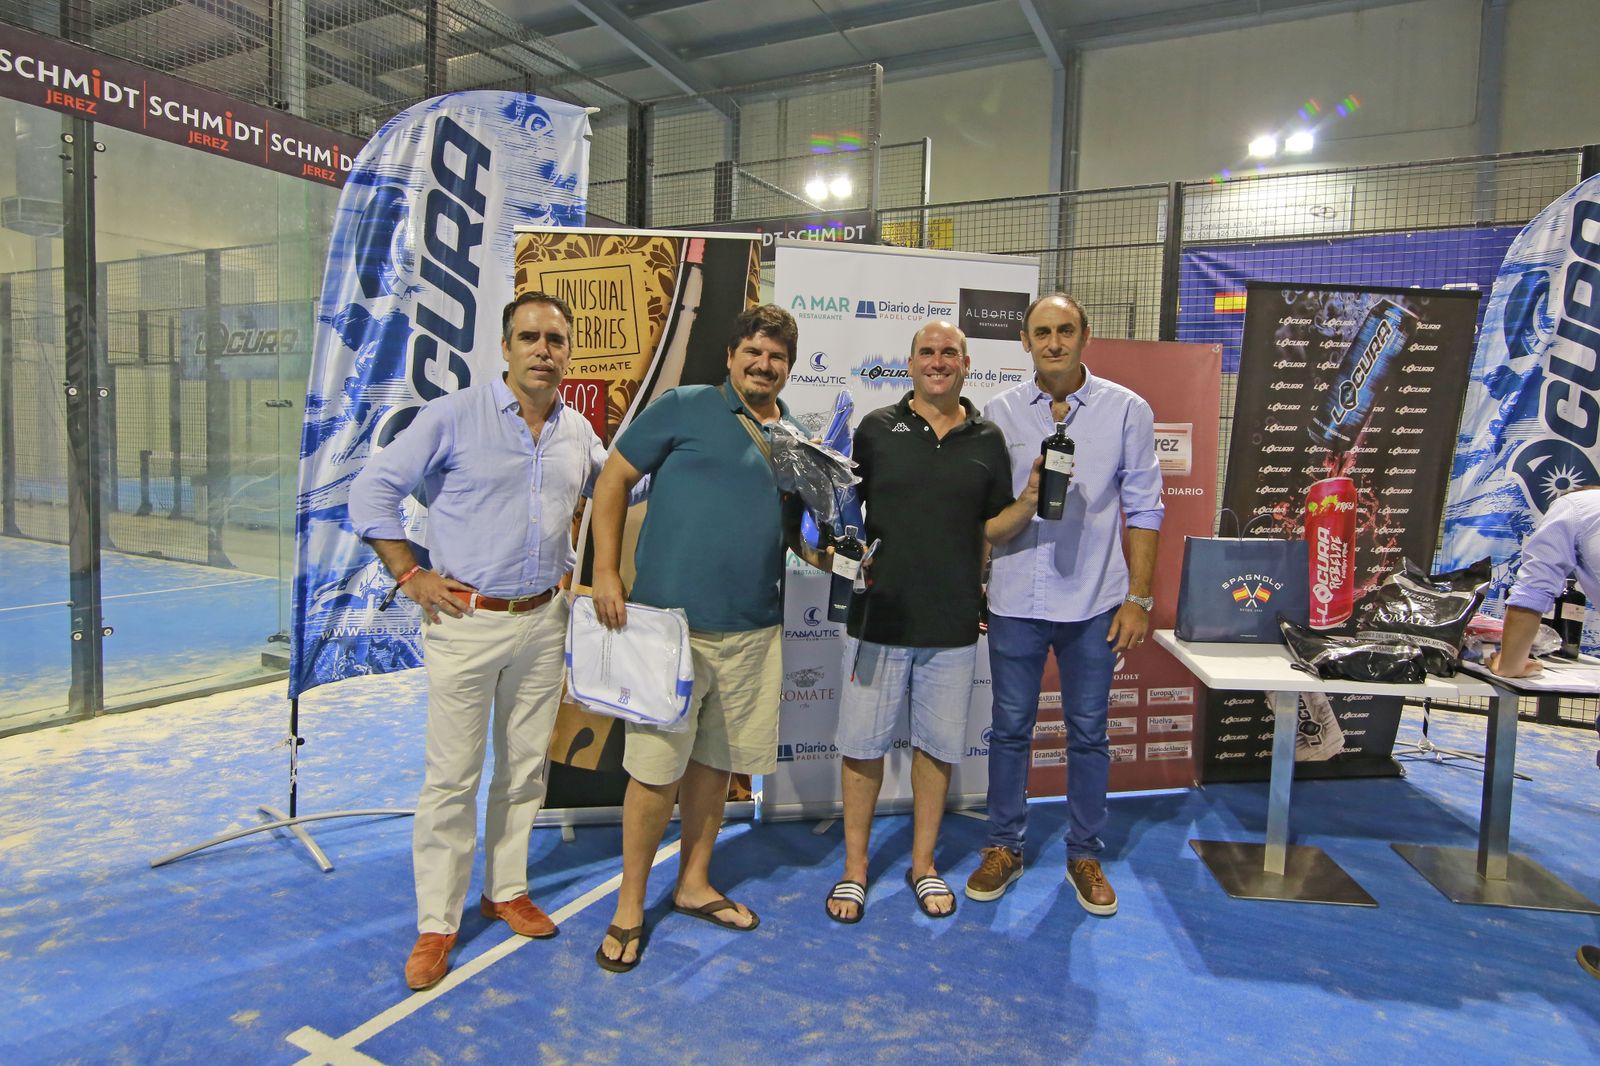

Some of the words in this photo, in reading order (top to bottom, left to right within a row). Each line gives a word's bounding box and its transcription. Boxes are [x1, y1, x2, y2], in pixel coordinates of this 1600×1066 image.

[45, 88, 97, 115] JEREZ
[188, 130, 229, 152] JEREZ
[270, 132, 356, 173] SCHMiD
[302, 163, 337, 182] JEREZ
[556, 278, 628, 312] UNUSUAL
[810, 295, 850, 312] MAR
[878, 301, 910, 314] Diario
[912, 303, 925, 314] de
[926, 303, 952, 317] Jerez
[798, 312, 843, 321] RESTAURANTE
[879, 313, 904, 321] PADEL
[965, 308, 1024, 321] ALBORES
[1279, 316, 1312, 326] LOCURA
[572, 316, 628, 350] ERRIES
[1276, 338, 1309, 347] LOCURA
[581, 361, 632, 374] ROMATE
[1273, 360, 1306, 369] LOCURA
[1402, 364, 1435, 373] LOCURA
[985, 370, 997, 381] de
[999, 370, 1022, 383] Jerez
[1331, 319, 1393, 425] LOCURA
[790, 375, 846, 385] FANAUTIC
[1270, 381, 1303, 390] LOCURA
[1398, 385, 1431, 394] LOCURA
[558, 383, 599, 416] GO?
[1267, 402, 1300, 412] LOCURA
[1395, 406, 1428, 415] LOCURA
[1264, 424, 1298, 433] LOCURA
[1391, 426, 1424, 435] LOCURA
[1154, 438, 1179, 452] rez
[1261, 444, 1295, 454] LOCURA
[1388, 447, 1420, 455] LOCURA
[1258, 465, 1292, 474] LOCURA
[1384, 467, 1417, 476] LOCURA
[1168, 487, 1204, 495] DIARIO
[1256, 485, 1288, 495] LOCURA
[1381, 487, 1413, 495] LOCURA
[1377, 507, 1409, 515] LOCURA
[1312, 526, 1334, 625] LOCURA
[1222, 574, 1282, 590] SPAGNOLO
[1372, 611, 1436, 627] ROMATE
[785, 630, 840, 639] FANAUTIC
[1223, 698, 1254, 706] LOCURA
[795, 742, 827, 754] Diario
